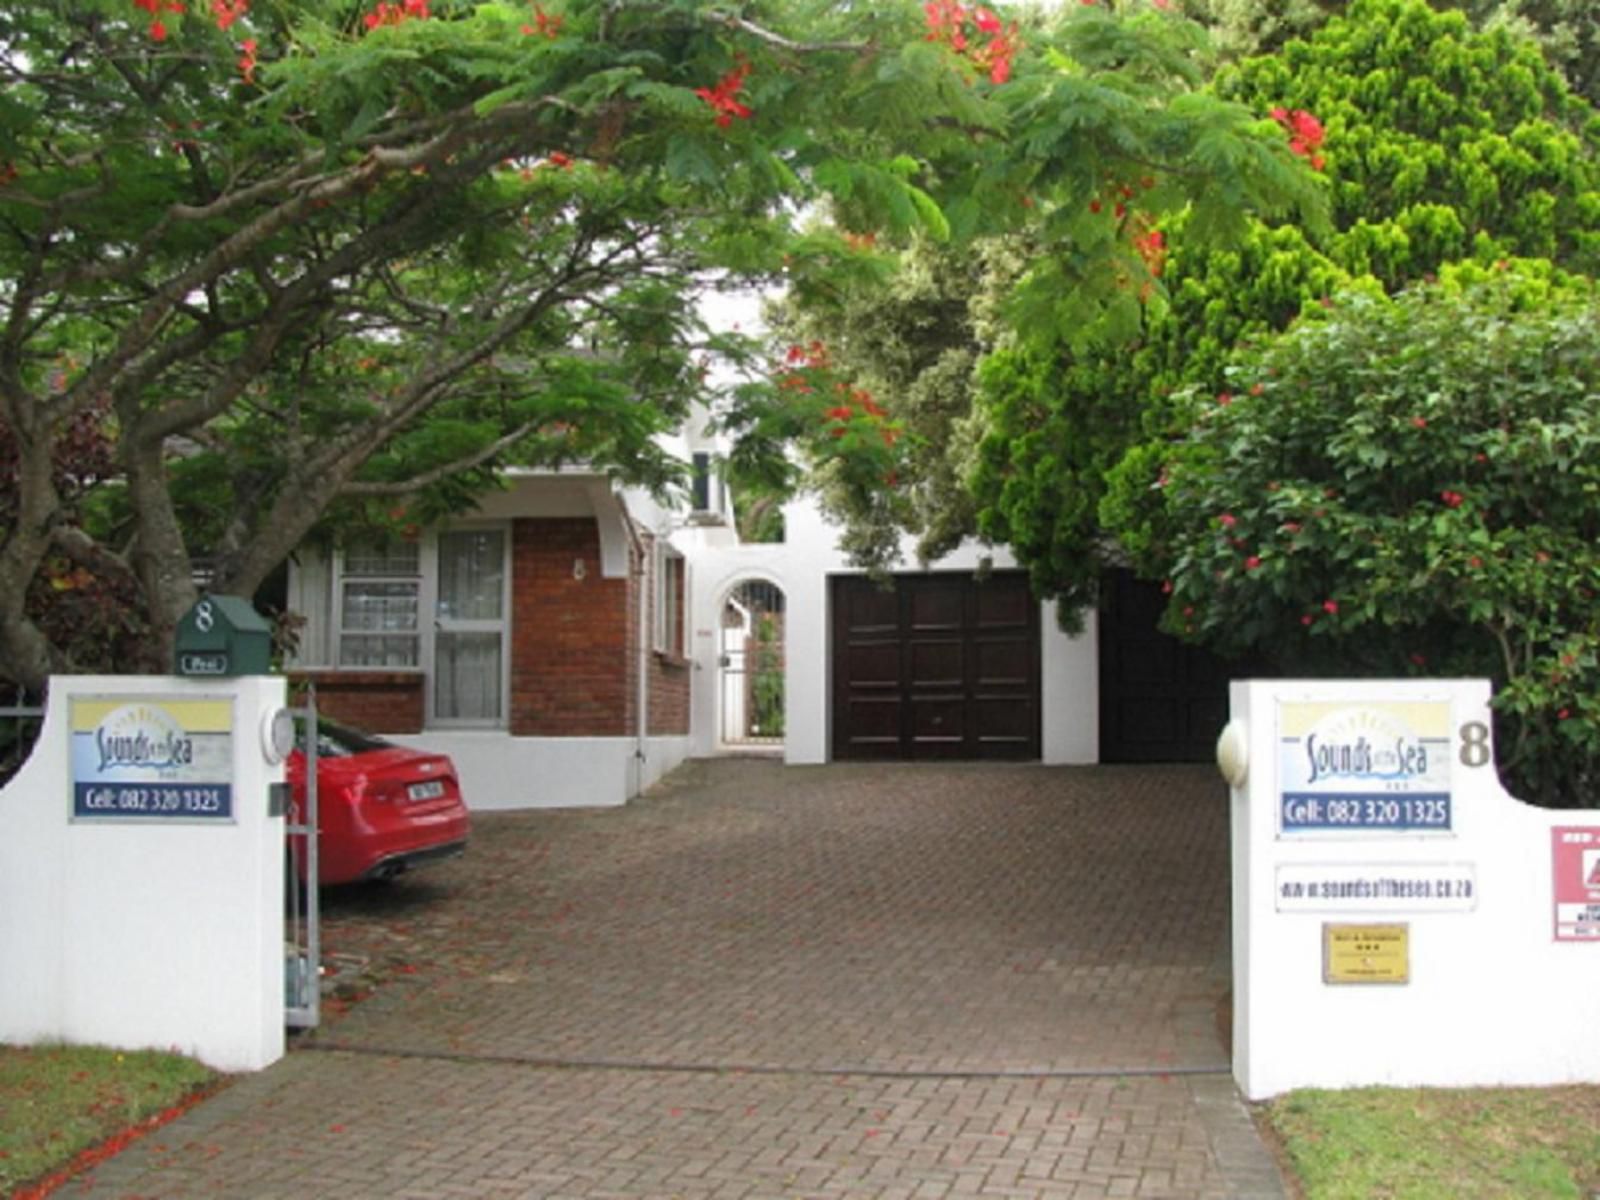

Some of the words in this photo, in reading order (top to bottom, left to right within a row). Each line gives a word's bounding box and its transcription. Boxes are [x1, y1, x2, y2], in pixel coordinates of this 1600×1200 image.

[195, 600, 214, 633] 8
[97, 726, 149, 773] Sounds
[166, 729, 193, 766] Sea
[1307, 732, 1371, 784] Sounds
[1397, 736, 1428, 775] Sea
[1458, 720, 1491, 768] 8
[85, 788, 116, 809] Cell:
[118, 789, 149, 809] 082
[150, 790, 180, 811] 320
[183, 790, 220, 812] 1325
[1284, 799, 1324, 823] Cell:
[1327, 800, 1360, 824] 082
[1364, 800, 1400, 823] 320
[1403, 800, 1447, 824] 1325
